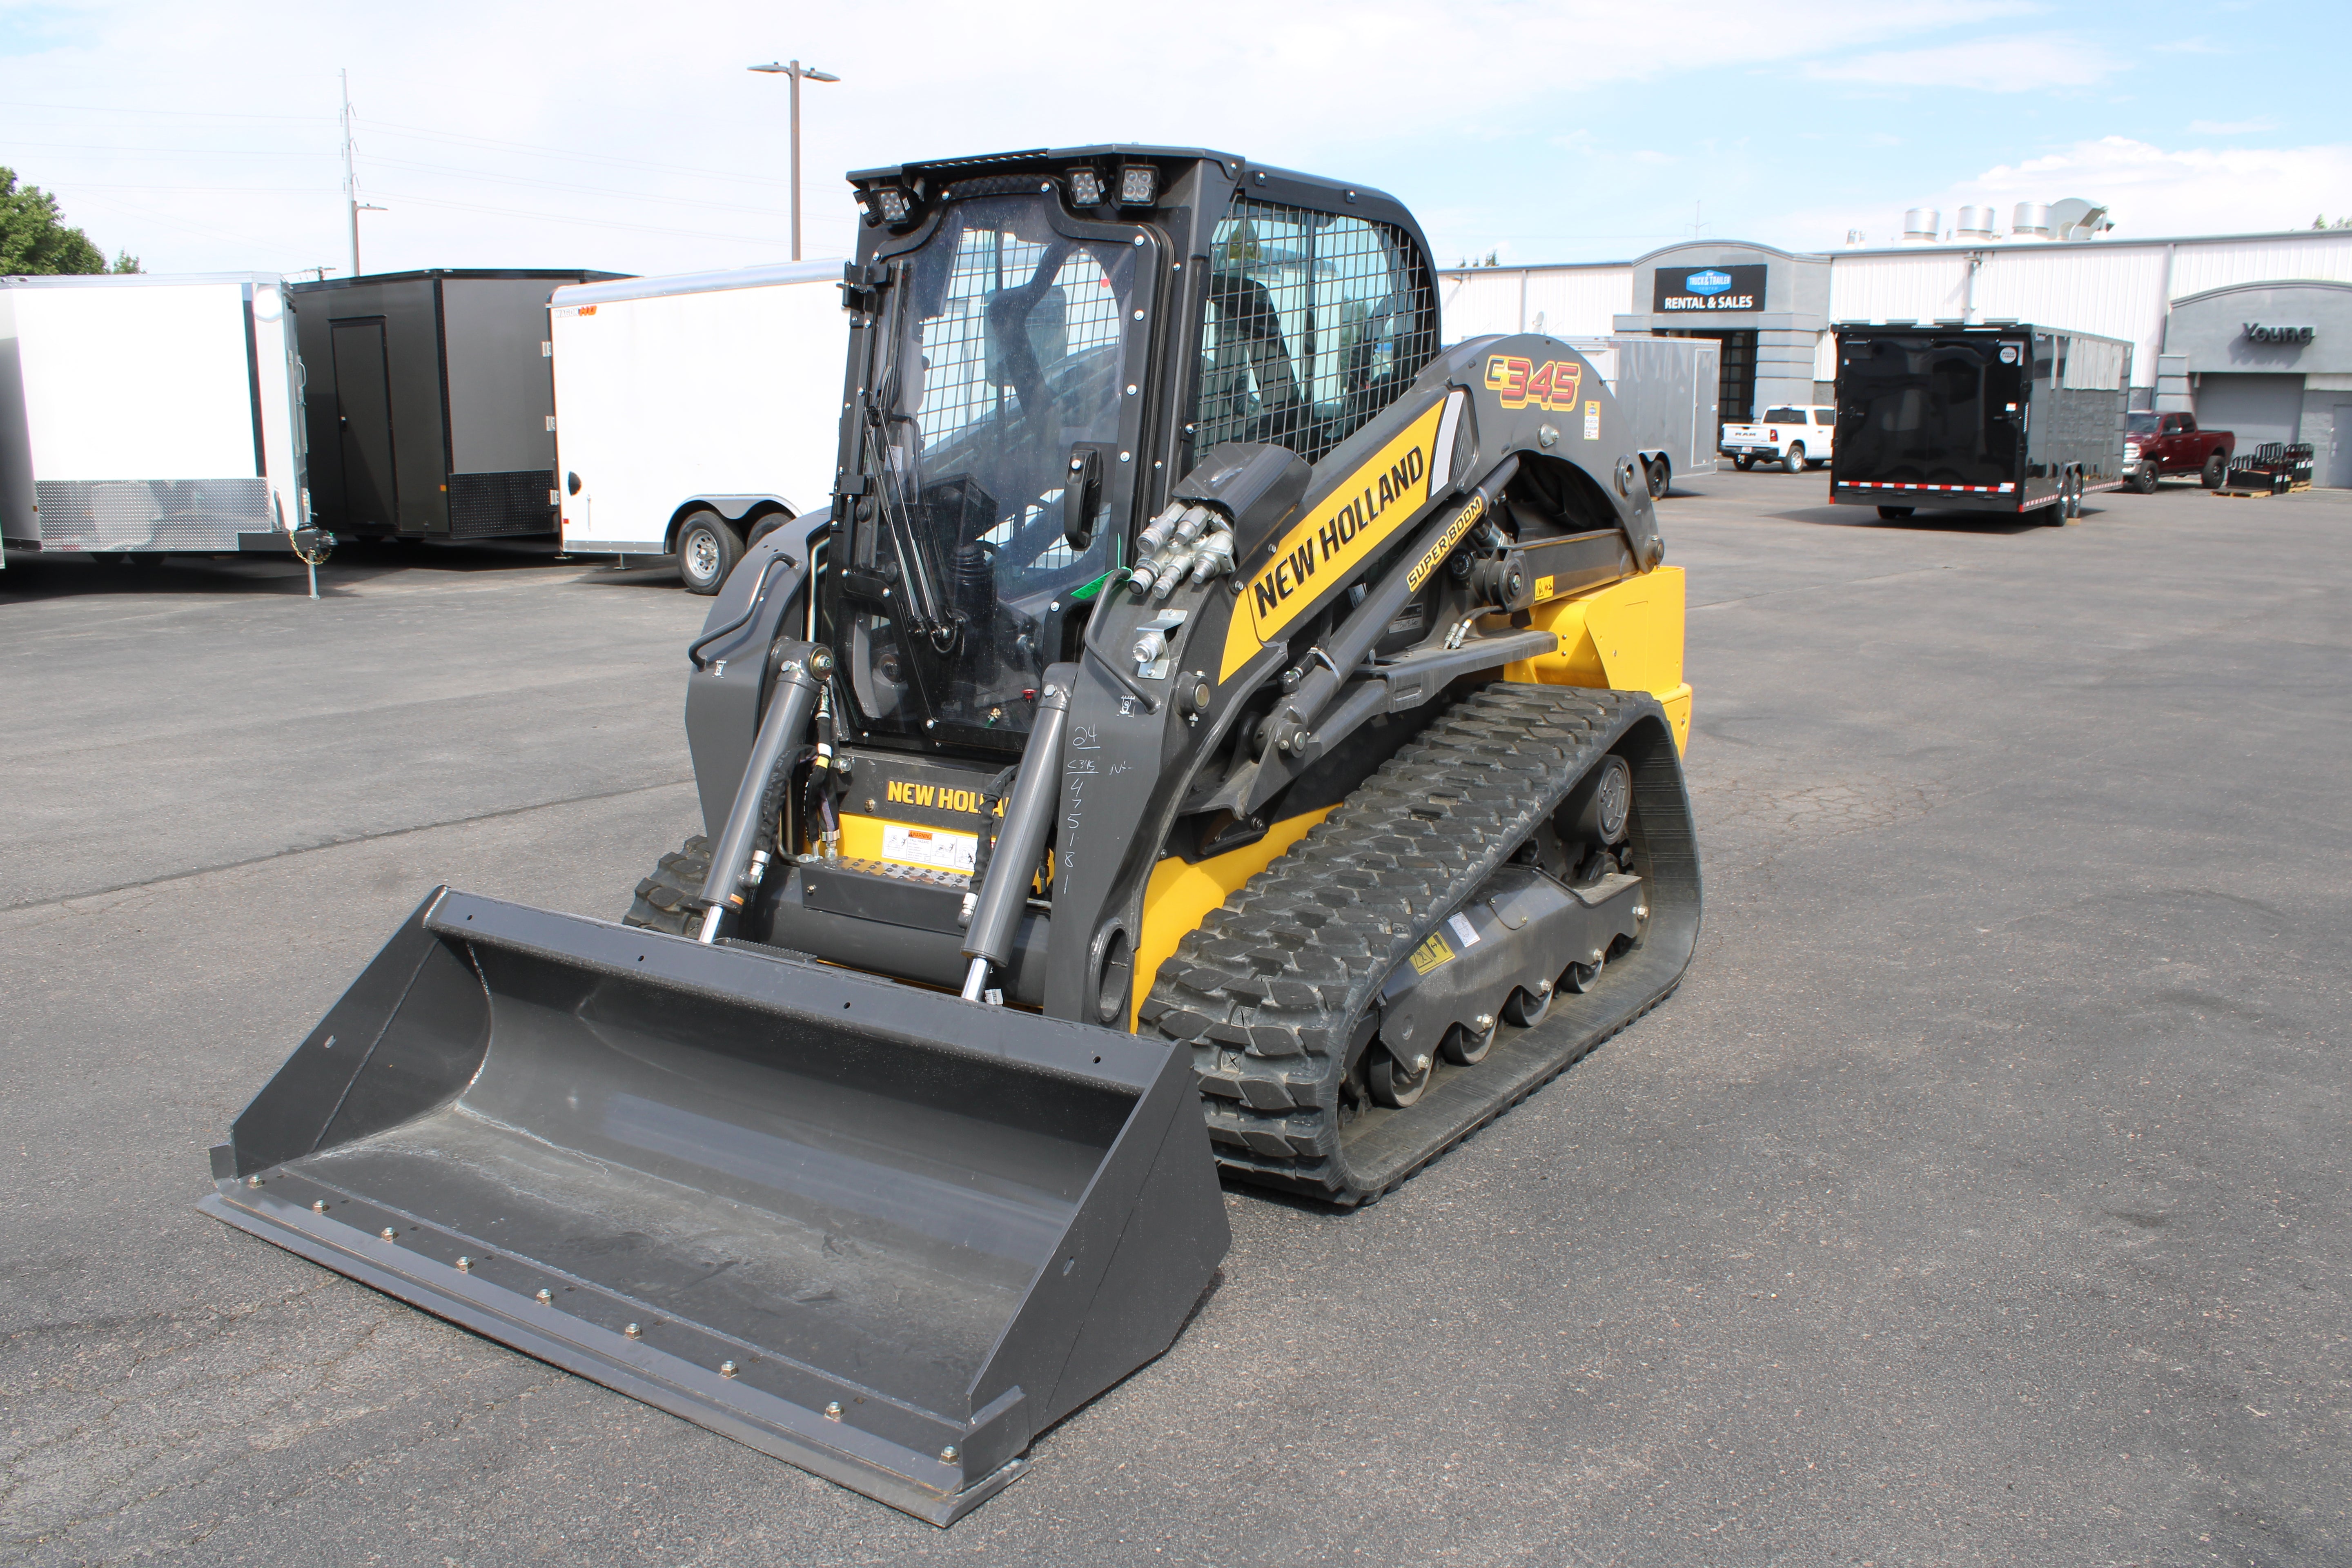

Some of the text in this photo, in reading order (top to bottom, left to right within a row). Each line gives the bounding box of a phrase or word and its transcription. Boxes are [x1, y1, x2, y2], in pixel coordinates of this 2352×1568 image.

[1689, 276, 1704, 285] TRUCK
[1709, 276, 1731, 285] TRAILER
[555, 307, 579, 318] WAGON
[1664, 295, 1753, 309] RENTAL & SALES
[2242, 323, 2314, 345] Young
[1486, 356, 1580, 409] C345
[1254, 445, 1424, 621] NEW HOLLAND
[1407, 536, 1449, 590] SUPER
[1447, 497, 1482, 545] BOOM
[1073, 723, 1097, 746] 24
[887, 780, 935, 807] NEW
